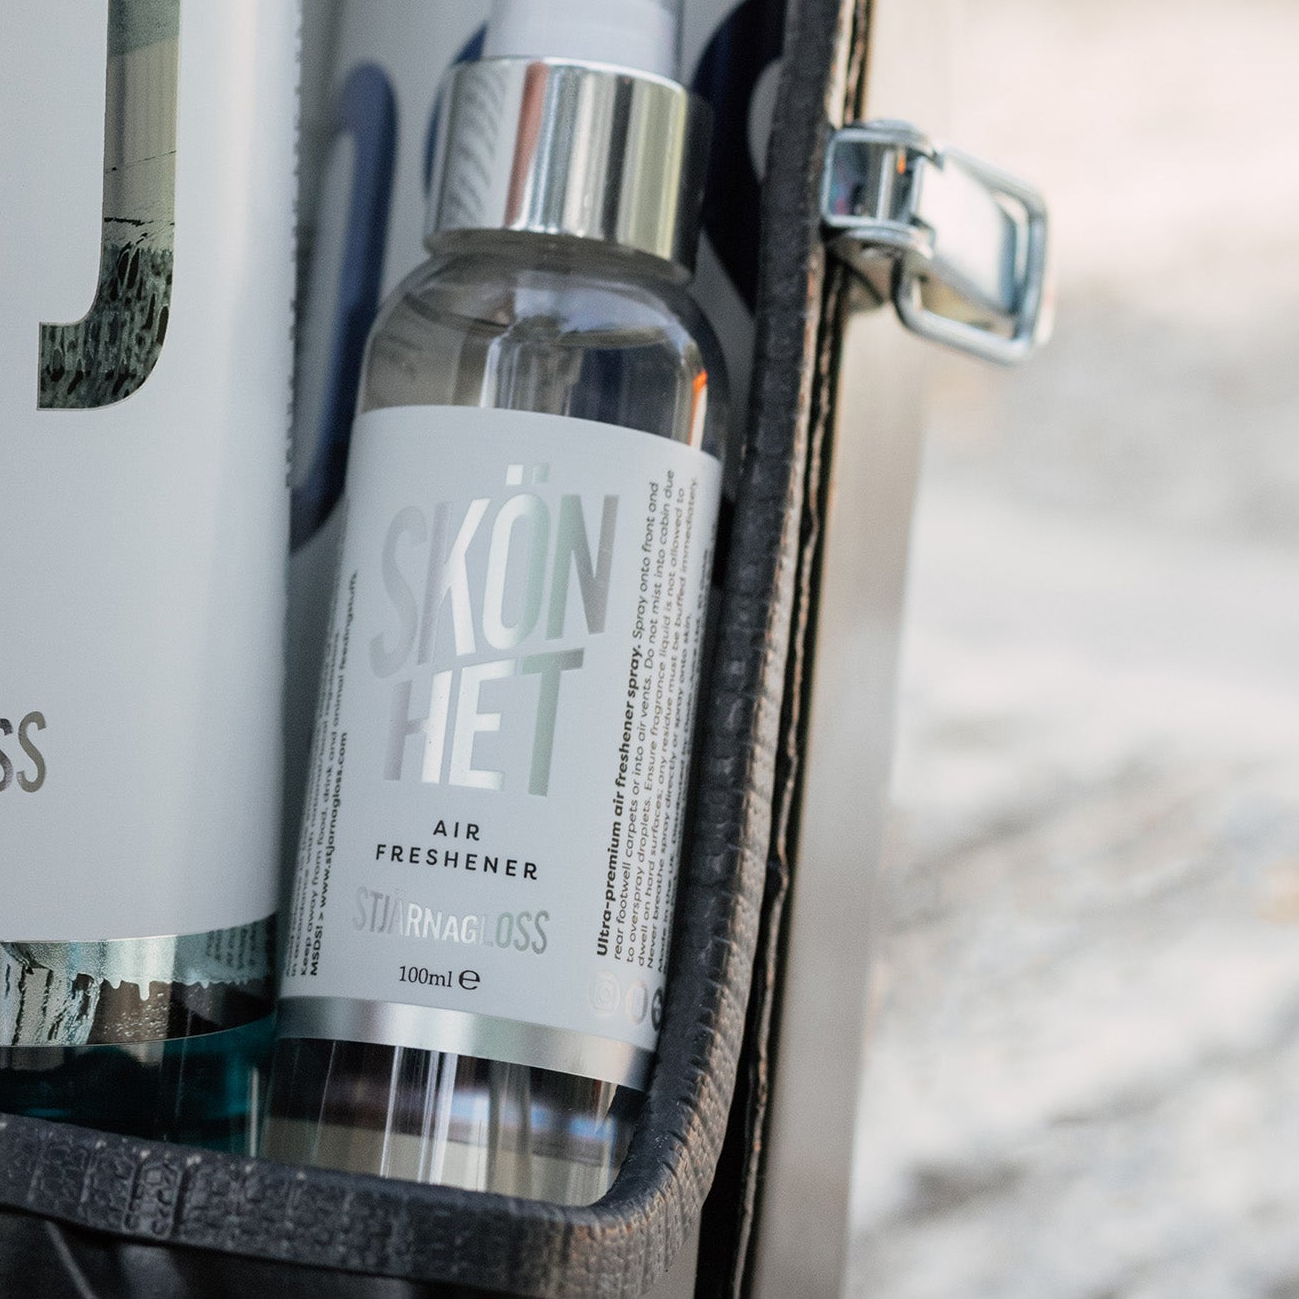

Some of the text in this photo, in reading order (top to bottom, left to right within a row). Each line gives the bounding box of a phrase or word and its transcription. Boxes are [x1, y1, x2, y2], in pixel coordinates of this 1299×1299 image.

[369, 463, 620, 679] SKÖN
[674, 577, 686, 627] buffed
[672, 632, 680, 651] be
[669, 656, 677, 693] must
[383, 647, 586, 798] HET
[597, 482, 658, 956] Ultra-premium air freshener spray. Spray onto front and
[615, 470, 674, 960] rear footwell carpets or into air vents. Do not mist into cabin due
[626, 488, 684, 963] to overspray droplets. Ensure fragrance liquid is not allowed to
[662, 697, 673, 752] residue
[647, 614, 692, 969] Never breathe spray directly or spray onto skin.
[659, 756, 667, 785] any
[310, 926, 322, 976] MSDS!
[320, 733, 347, 908] www.stjarnagloss.com
[433, 819, 480, 841] AIR
[375, 843, 538, 881] FRESHENER
[645, 860, 655, 897] hard
[353, 885, 551, 955] STJÄRNAGLOSS
[644, 901, 650, 921] on
[638, 925, 648, 967] dwell
[399, 965, 453, 988] 100ml
